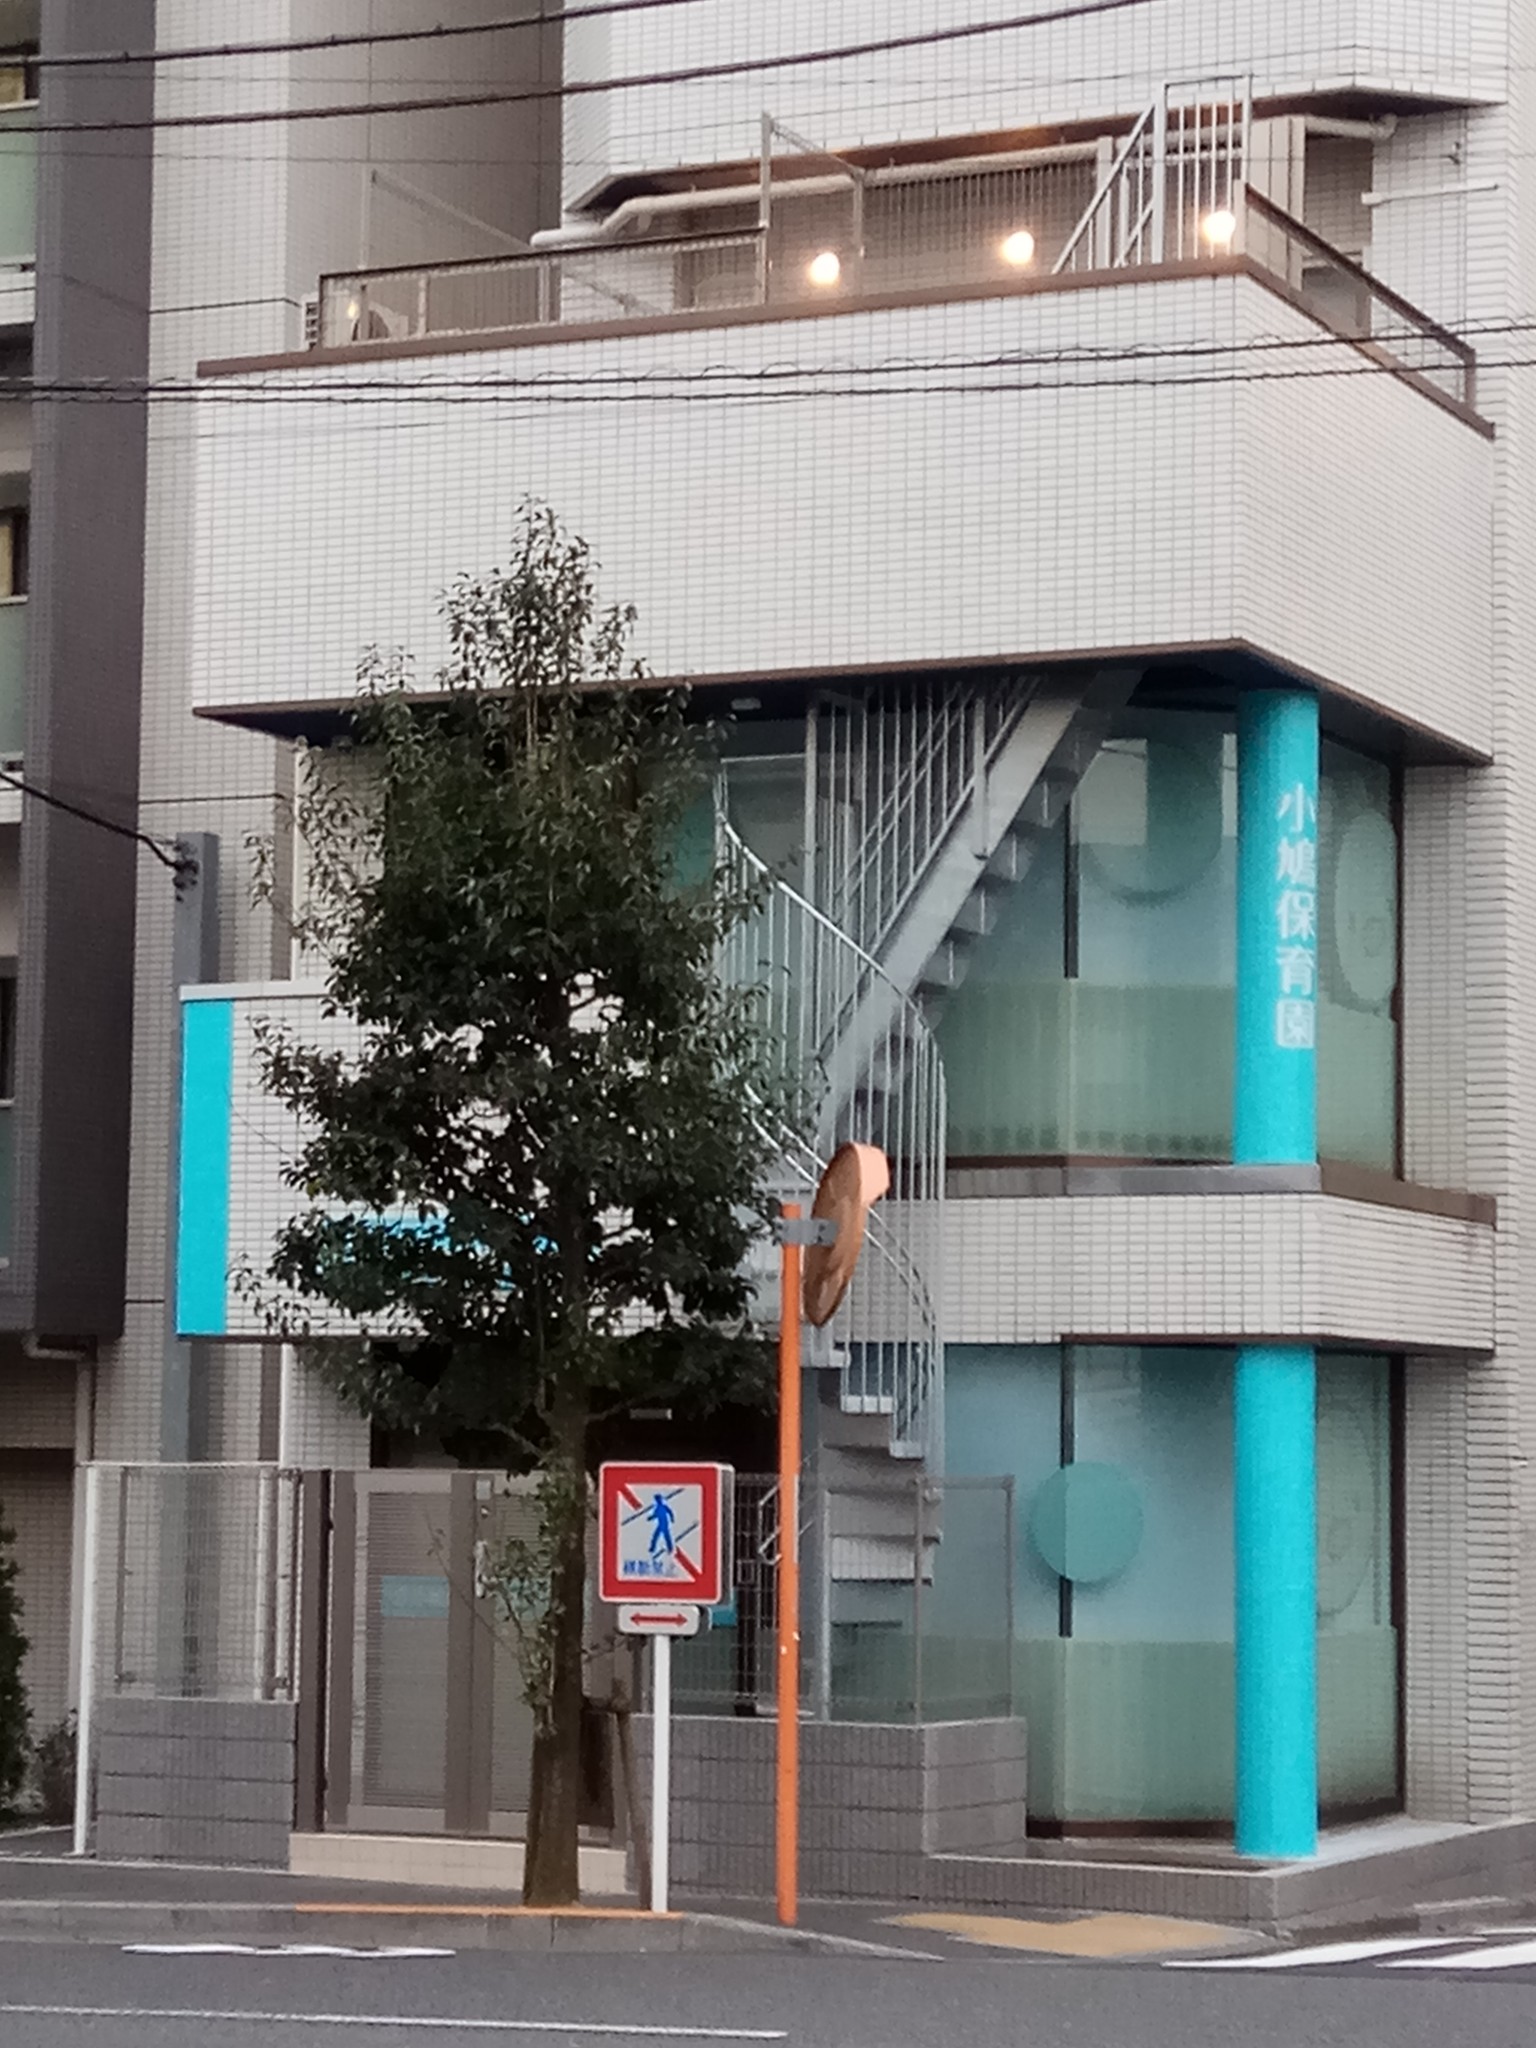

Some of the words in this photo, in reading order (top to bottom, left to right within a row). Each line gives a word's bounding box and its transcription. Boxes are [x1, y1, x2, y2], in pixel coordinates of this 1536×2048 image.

[1275, 782, 1316, 1050] 小鳩保育園
